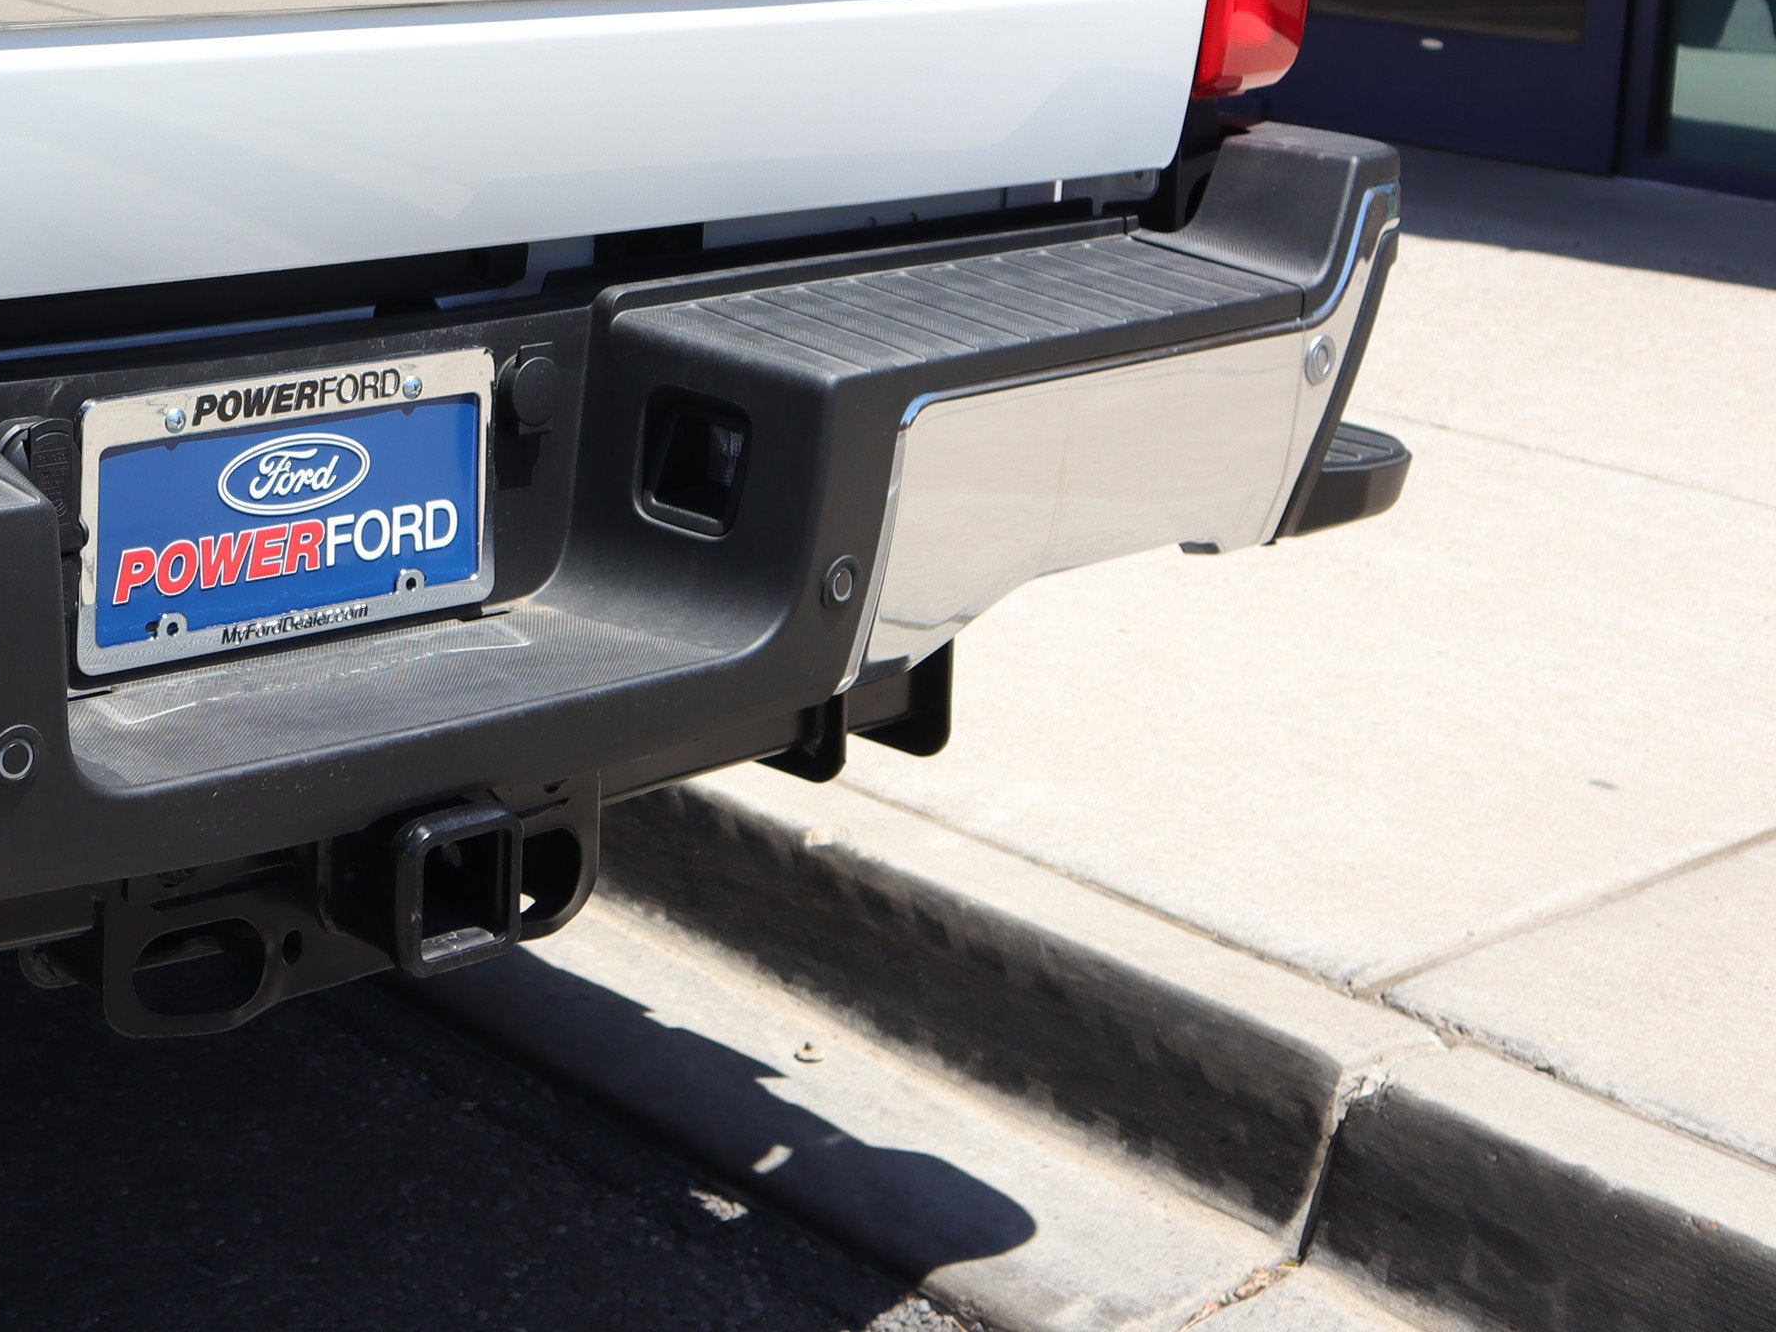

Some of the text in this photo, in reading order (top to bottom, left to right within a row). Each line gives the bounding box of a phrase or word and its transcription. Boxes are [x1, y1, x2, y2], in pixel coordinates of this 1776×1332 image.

[191, 368, 401, 426] POWERFORD
[248, 447, 339, 500] Ford
[112, 498, 459, 606] POWERFORD
[221, 603, 369, 646] MyFordDealer.com
